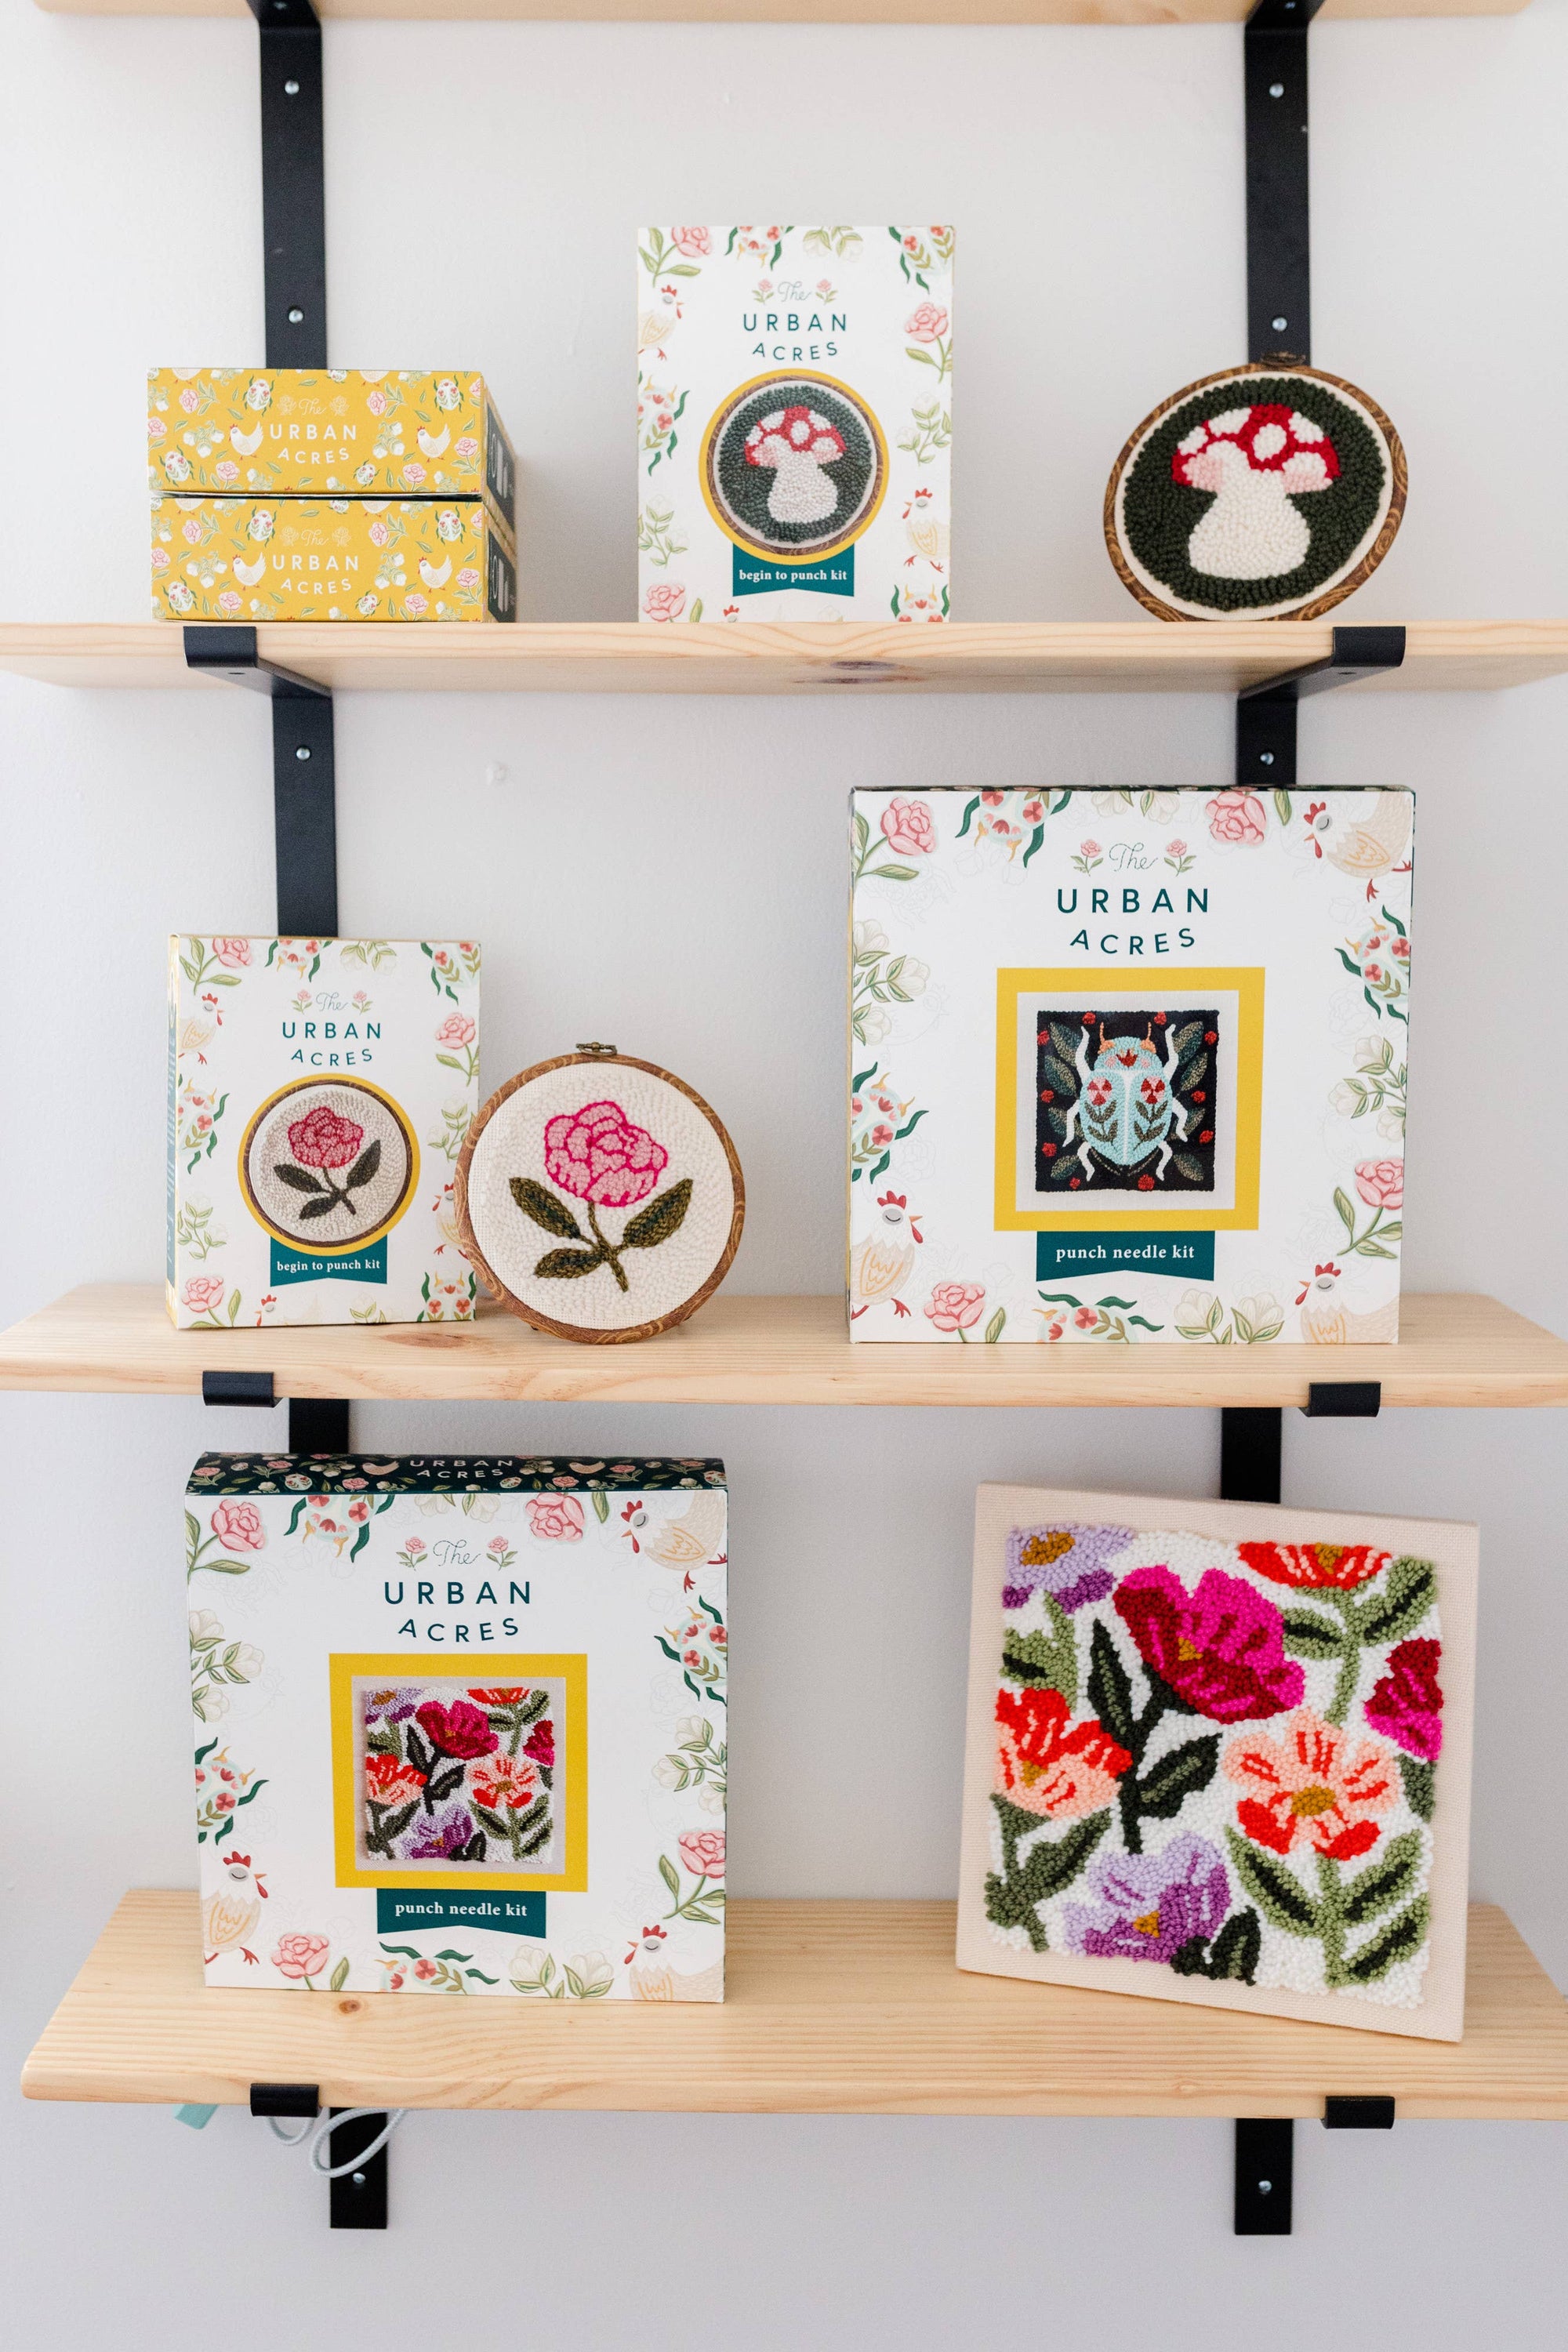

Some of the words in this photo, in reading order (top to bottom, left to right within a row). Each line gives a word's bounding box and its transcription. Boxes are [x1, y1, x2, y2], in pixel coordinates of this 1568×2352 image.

[778, 281, 812, 303] The
[743, 314, 846, 332] URBAN
[753, 342, 838, 361] ACRES
[299, 397, 327, 416] The
[270, 424, 357, 441] URBAN
[278, 447, 350, 464] ACRES
[301, 528, 329, 546] The
[273, 555, 359, 571] URBAN
[739, 568, 773, 583] begin
[775, 570, 787, 581] to
[790, 568, 828, 583] punch
[831, 568, 848, 580] kit
[281, 579, 352, 594] ACRES
[1109, 843, 1159, 873] The
[1057, 887, 1209, 913] URBAN
[1070, 927, 1195, 955] ACRES
[316, 992, 349, 1012] The
[282, 1022, 381, 1039] URBAN
[291, 1048, 372, 1066] ACRES
[1056, 1245, 1107, 1262] punch
[1112, 1244, 1167, 1260] needle
[1173, 1244, 1195, 1259] kit
[277, 1260, 310, 1273] begin
[312, 1261, 324, 1271] to
[326, 1260, 362, 1272] punch
[365, 1259, 381, 1269] kit
[417, 1469, 503, 1479] ACRES
[433, 1540, 481, 1567] The
[384, 1581, 531, 1605] URBAN
[398, 1617, 519, 1642] ACRES
[394, 1901, 445, 1919] punch
[449, 1902, 501, 1917] needle
[506, 1902, 528, 1916] kit
